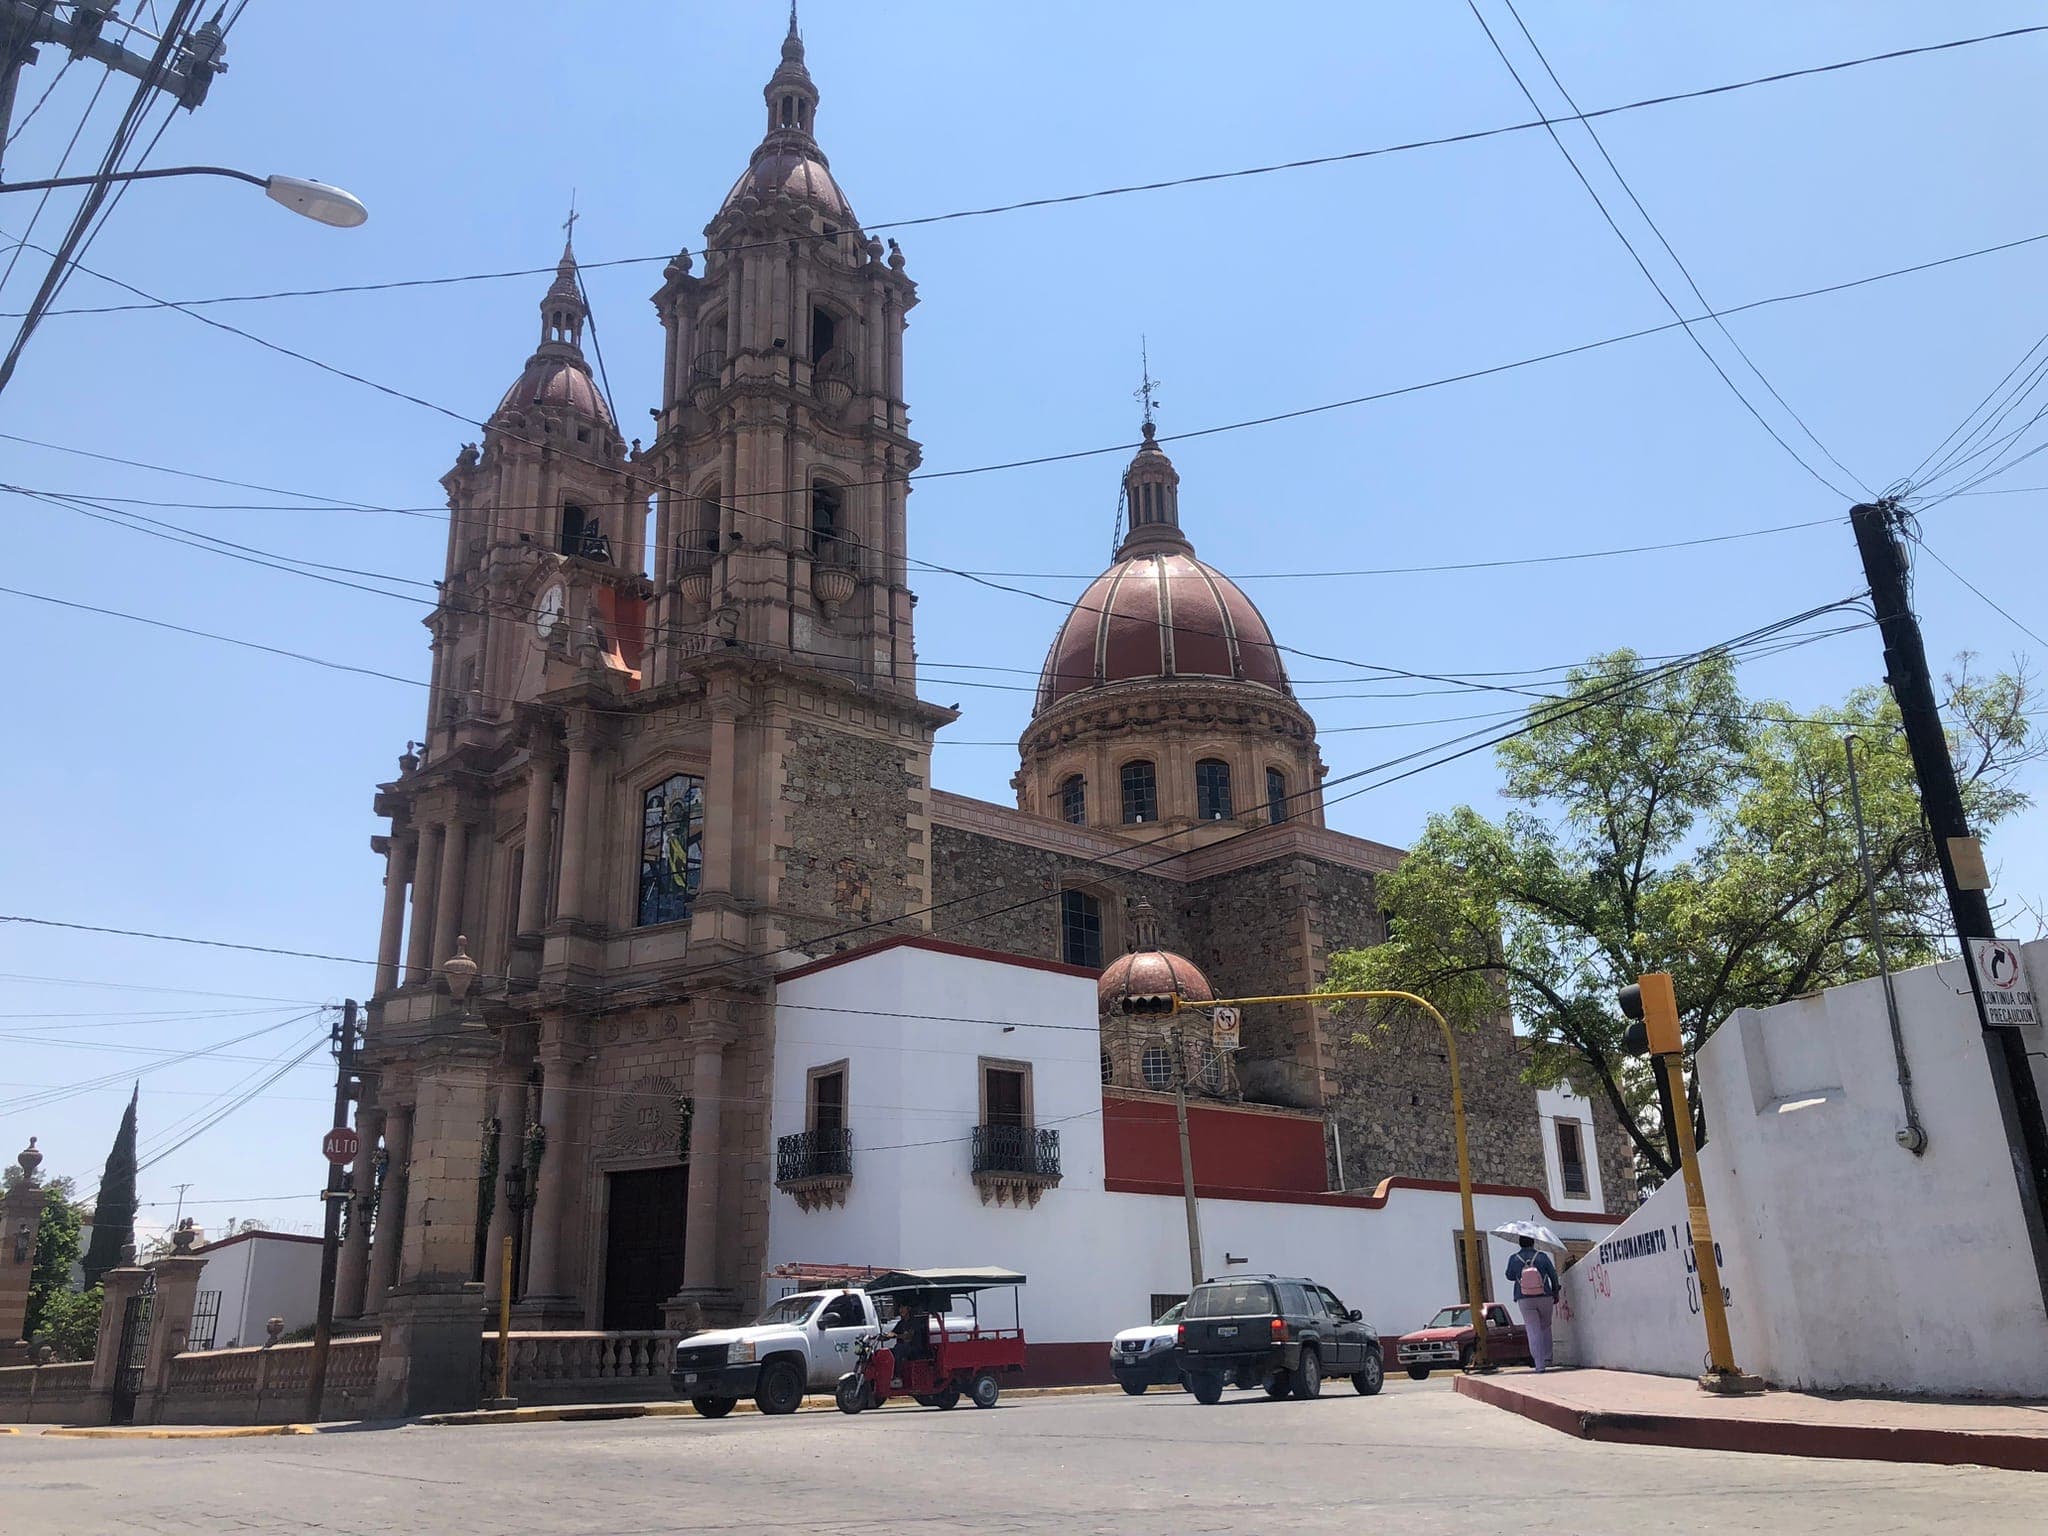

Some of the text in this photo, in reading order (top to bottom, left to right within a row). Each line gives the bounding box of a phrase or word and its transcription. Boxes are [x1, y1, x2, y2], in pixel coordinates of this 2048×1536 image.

[1981, 991, 2033, 1005] CONTINUA CON
[1989, 1008, 2034, 1022] PRECAUCION
[326, 1139, 357, 1153] ALTO
[1600, 1229, 1666, 1264] ESTACIONAMIENTO
[1671, 1224, 1679, 1249] Y
[1684, 1243, 1723, 1273] LAO
[835, 1343, 849, 1352] CFE
